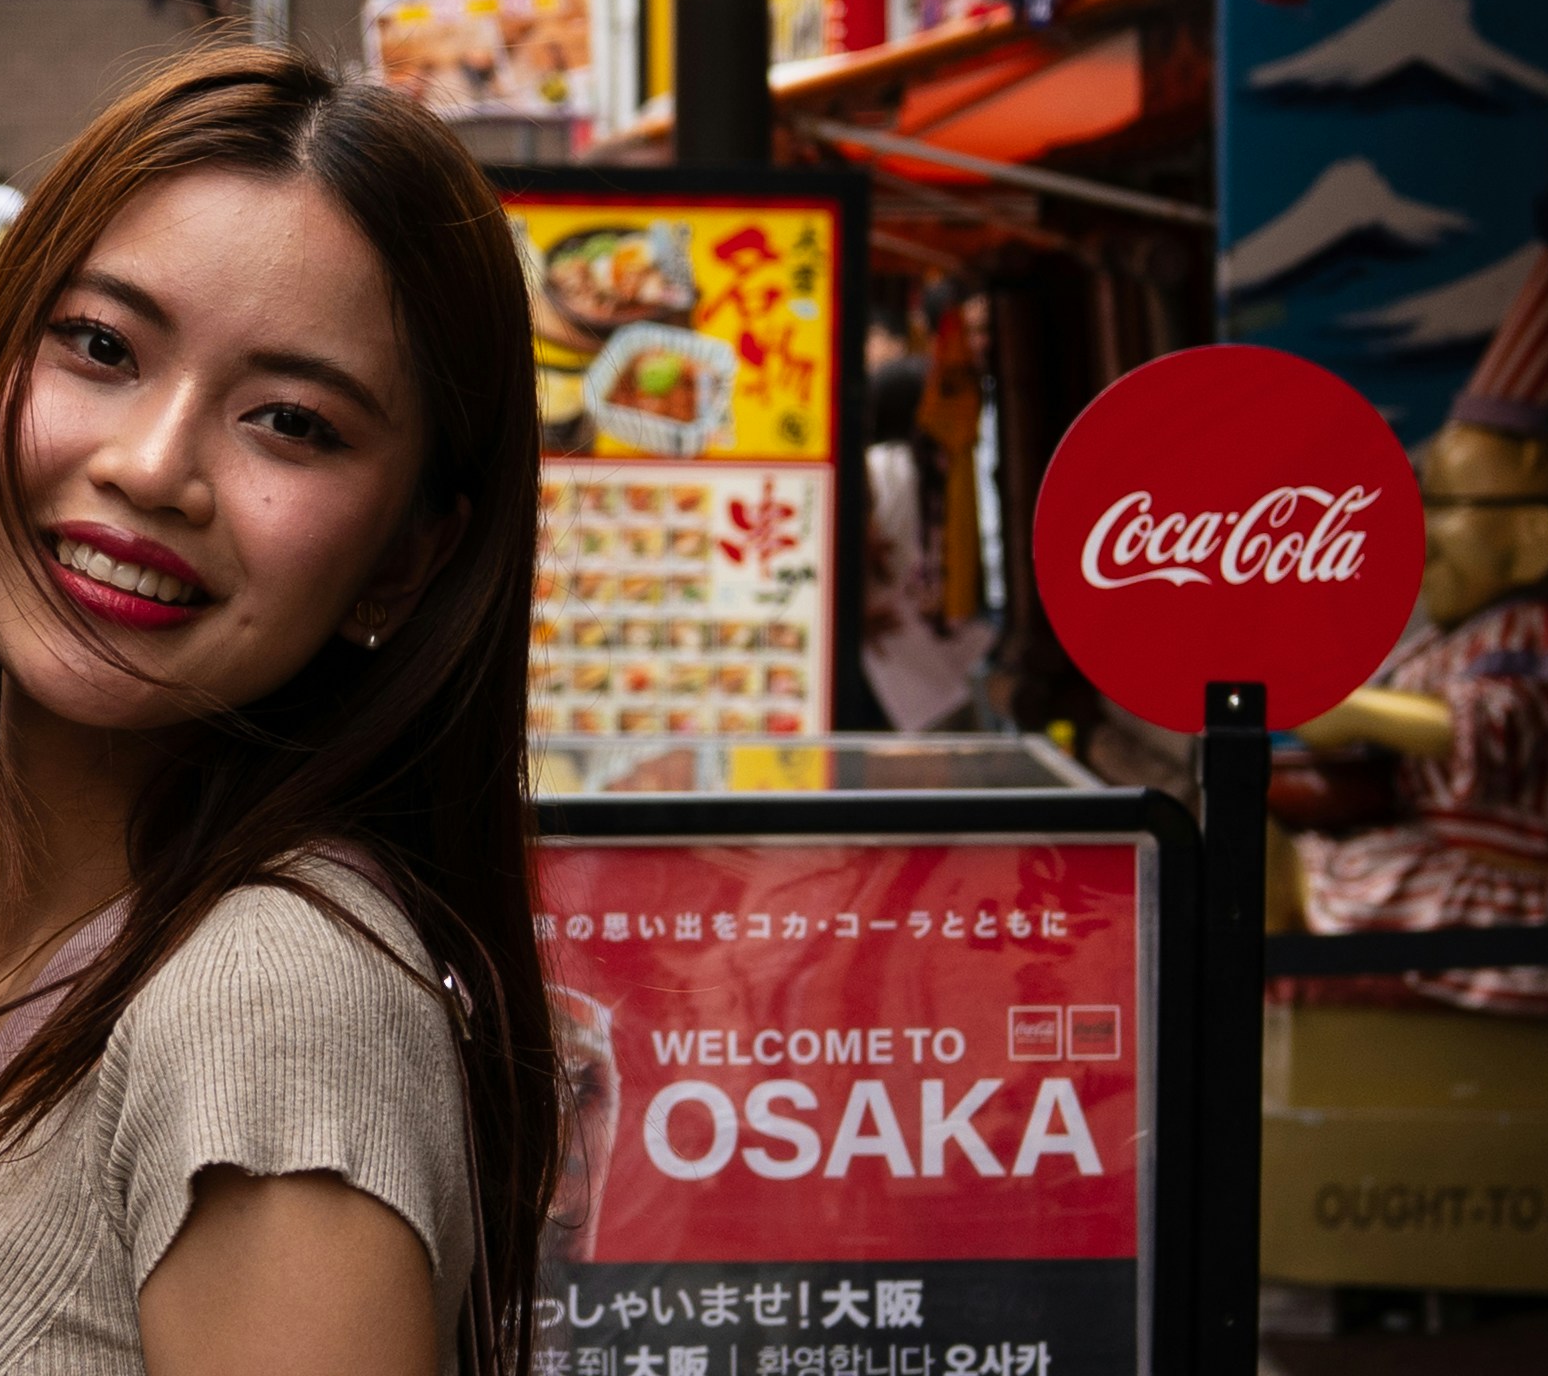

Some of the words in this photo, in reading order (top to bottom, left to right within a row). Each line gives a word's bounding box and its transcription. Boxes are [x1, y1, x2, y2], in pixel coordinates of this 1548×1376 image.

[1081, 485, 1382, 590] Coca-Cola
[652, 1028, 894, 1067] WELCOME
[904, 1027, 967, 1064] TO
[642, 1077, 1104, 1182] OSAKA
